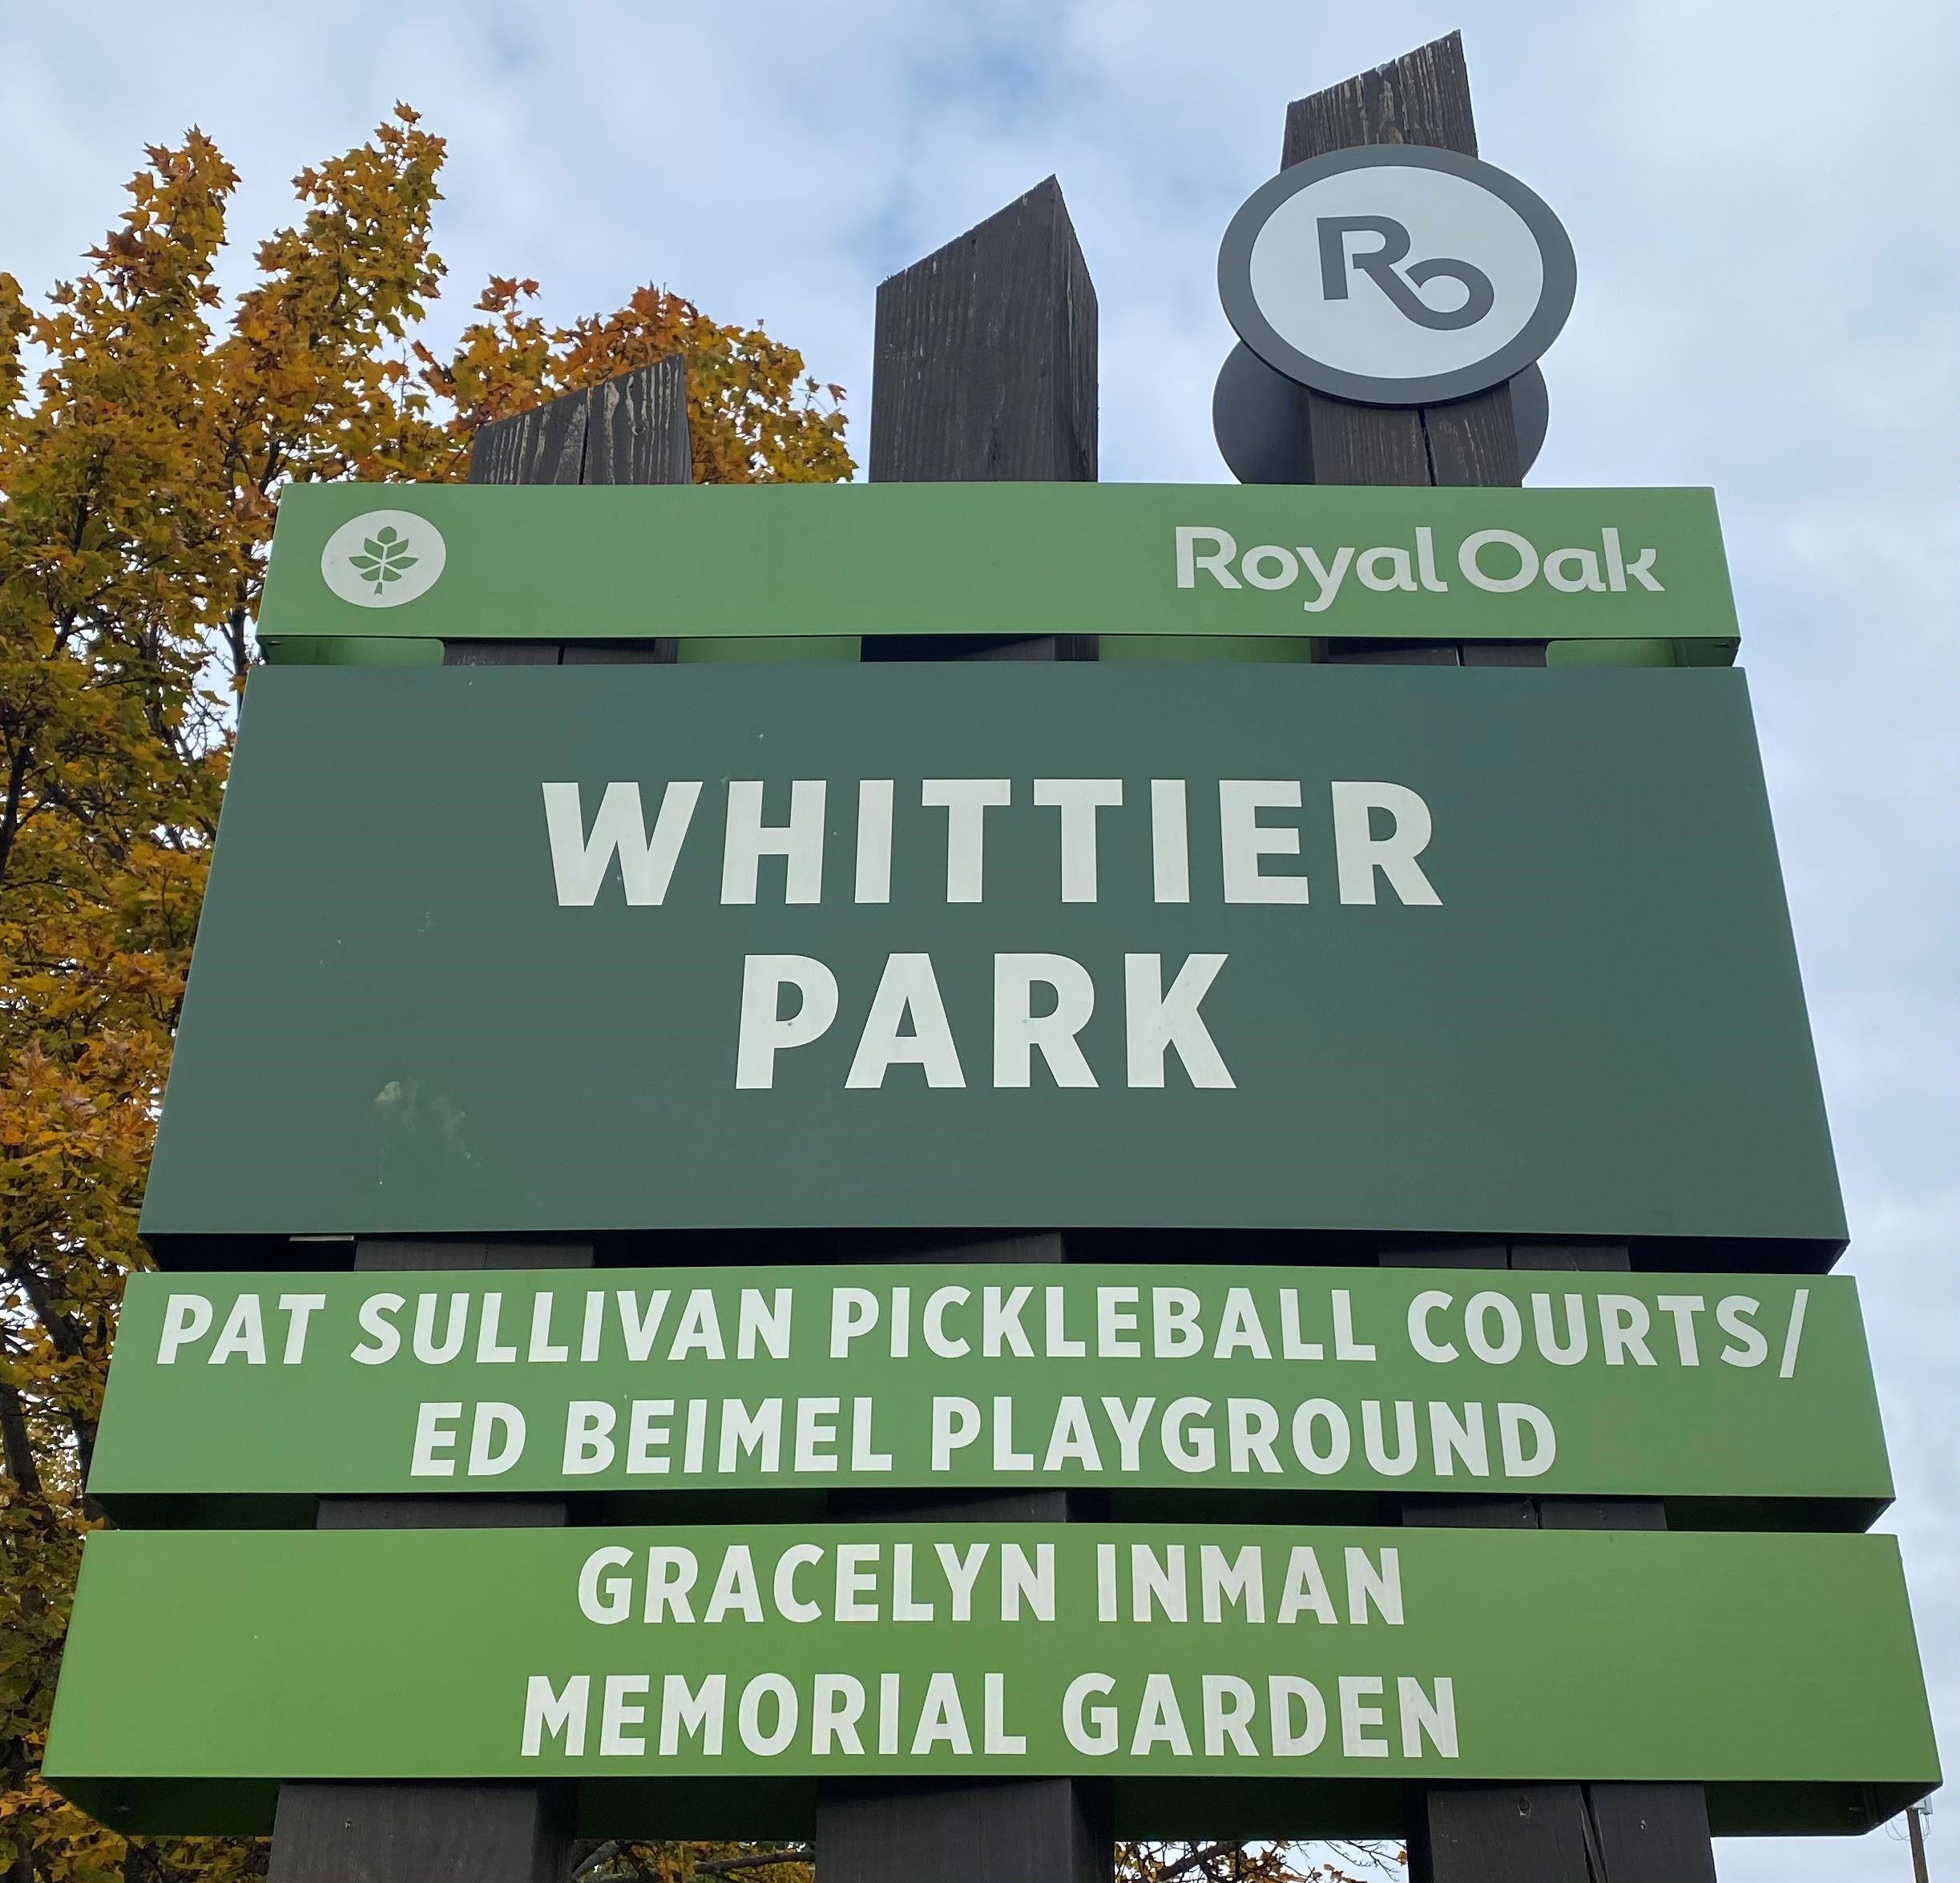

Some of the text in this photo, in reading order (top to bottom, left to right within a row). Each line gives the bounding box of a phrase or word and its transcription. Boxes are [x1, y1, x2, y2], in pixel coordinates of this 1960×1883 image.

[1175, 526, 1666, 612] Royal Oak
[542, 779, 1443, 906] WHITTIER
[735, 953, 1237, 1090] PARK
[156, 1285, 1810, 1378] PAT SULLIVAN PICKLEBALL COURTS/
[410, 1396, 1556, 1478] ED BEIMEL PLAYGROUND
[578, 1543, 1405, 1626] GRACELYN INMAN
[521, 1672, 1459, 1758] MEMORIAL GARDEN
